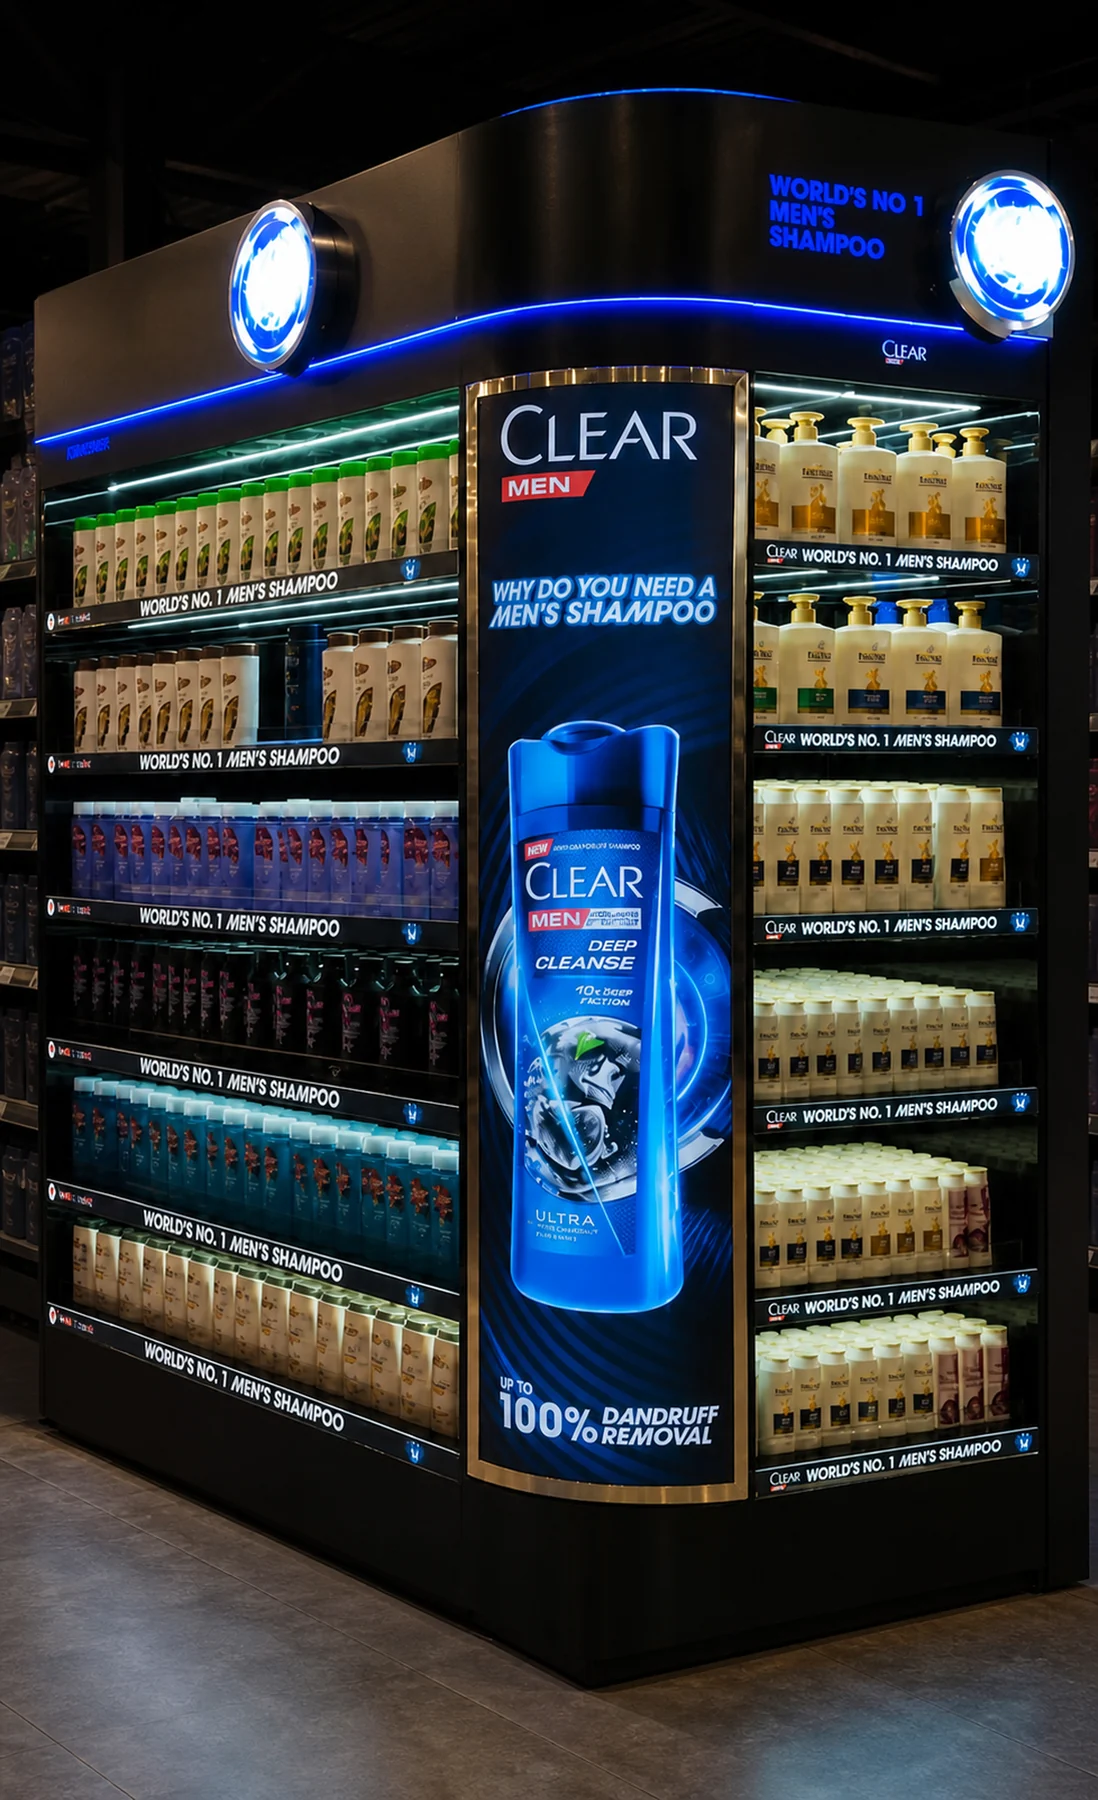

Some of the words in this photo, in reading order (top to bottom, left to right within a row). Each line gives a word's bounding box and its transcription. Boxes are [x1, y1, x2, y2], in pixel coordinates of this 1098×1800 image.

[769, 173, 867, 208] WORLD'S
[872, 191, 906, 213] NO
[913, 196, 924, 217] 1
[769, 200, 835, 229] MEN'S
[769, 226, 885, 260] SHAMPOO
[882, 339, 927, 362] CLEAR
[500, 404, 698, 466] CLEAR
[508, 476, 571, 497] MEN
[765, 543, 798, 560] CLEAR
[801, 548, 857, 565] WORLD'S
[859, 551, 882, 567] NO.
[885, 552, 892, 567] 1
[894, 553, 934, 569] MEN'S
[936, 556, 999, 572] SHAMPOO
[140, 591, 189, 617] WORLD'S
[191, 590, 213, 609] NO.
[216, 589, 223, 606] 1
[225, 582, 266, 605] MEN'S
[268, 571, 339, 599] SHAMPOO
[493, 579, 535, 603] WHY
[537, 577, 572, 600] DO
[577, 577, 628, 598] YOU
[633, 577, 695, 597] NEED
[697, 576, 715, 597] A
[489, 603, 560, 628] MEN'S
[566, 600, 715, 625] SHAMPOO
[764, 729, 796, 745] CLEAR
[800, 733, 855, 747] WORLD'S
[857, 733, 881, 747] NO.
[883, 733, 890, 747] 1
[892, 733, 932, 747] MEN'S
[934, 733, 997, 748] SHAMPOO
[139, 752, 190, 771] WORLD'S
[191, 751, 214, 769] NO.
[217, 751, 223, 769] 1
[225, 749, 266, 769] MEN'S
[269, 746, 340, 767] SHAMPOO
[527, 842, 549, 857] NEW
[525, 861, 644, 901] CLEAR
[139, 906, 190, 928] WORLD'S
[191, 911, 213, 929] NO.
[216, 911, 223, 930] 1
[225, 912, 266, 933] MEN'S
[269, 916, 340, 938] SHAMPOO
[531, 911, 581, 928] MEN
[764, 920, 797, 935] CLEAR
[801, 920, 856, 936] WORLD'S
[858, 919, 881, 934] NO.
[884, 918, 890, 933] 1
[893, 917, 933, 933] MEN'S
[934, 915, 998, 932] SHAMPOO
[588, 939, 638, 952] DEEP
[535, 956, 636, 971] CLEANSE
[139, 1056, 190, 1083] WORLD'S
[192, 1065, 214, 1087] NO.
[217, 1071, 223, 1089] 1
[226, 1072, 267, 1095] MEN'S
[270, 1078, 340, 1109] SHAMPOO
[765, 1109, 798, 1124] CLEAR
[802, 1107, 857, 1124] WORLD'S
[859, 1105, 882, 1121] NO.
[885, 1104, 892, 1118] 1
[894, 1102, 934, 1118] MEN'S
[935, 1097, 998, 1115] SHAMPOO
[535, 1208, 596, 1227] ULTRA
[143, 1208, 194, 1240] WORLD'S
[195, 1224, 218, 1247] NO.
[220, 1231, 227, 1249] 1
[229, 1235, 270, 1261] MEN'S
[272, 1247, 344, 1283] SHAMPOO
[768, 1302, 800, 1316] CLEAR
[804, 1297, 860, 1315] WORLD'S
[861, 1294, 885, 1309] NO.
[887, 1292, 894, 1306] 1
[897, 1287, 936, 1305] MEN'S
[938, 1279, 1001, 1299] SHAMPOO
[144, 1340, 195, 1376] WORLD'S
[196, 1360, 218, 1385] NO.
[221, 1370, 228, 1389] 1
[230, 1375, 271, 1405] MEN'S
[273, 1390, 345, 1433] SHAMPOO
[500, 1376, 514, 1390] UP
[516, 1380, 533, 1396] TO
[499, 1391, 599, 1445] 100%
[601, 1404, 720, 1427] DANDRUFF
[601, 1425, 713, 1446] REMOVAL
[769, 1471, 801, 1486] CLEAR
[806, 1462, 861, 1483] WORLD'S
[862, 1458, 886, 1474] NO.
[888, 1456, 895, 1470] 1
[898, 1449, 937, 1469] MEN'S
[939, 1439, 1002, 1462] SHAMPOO
